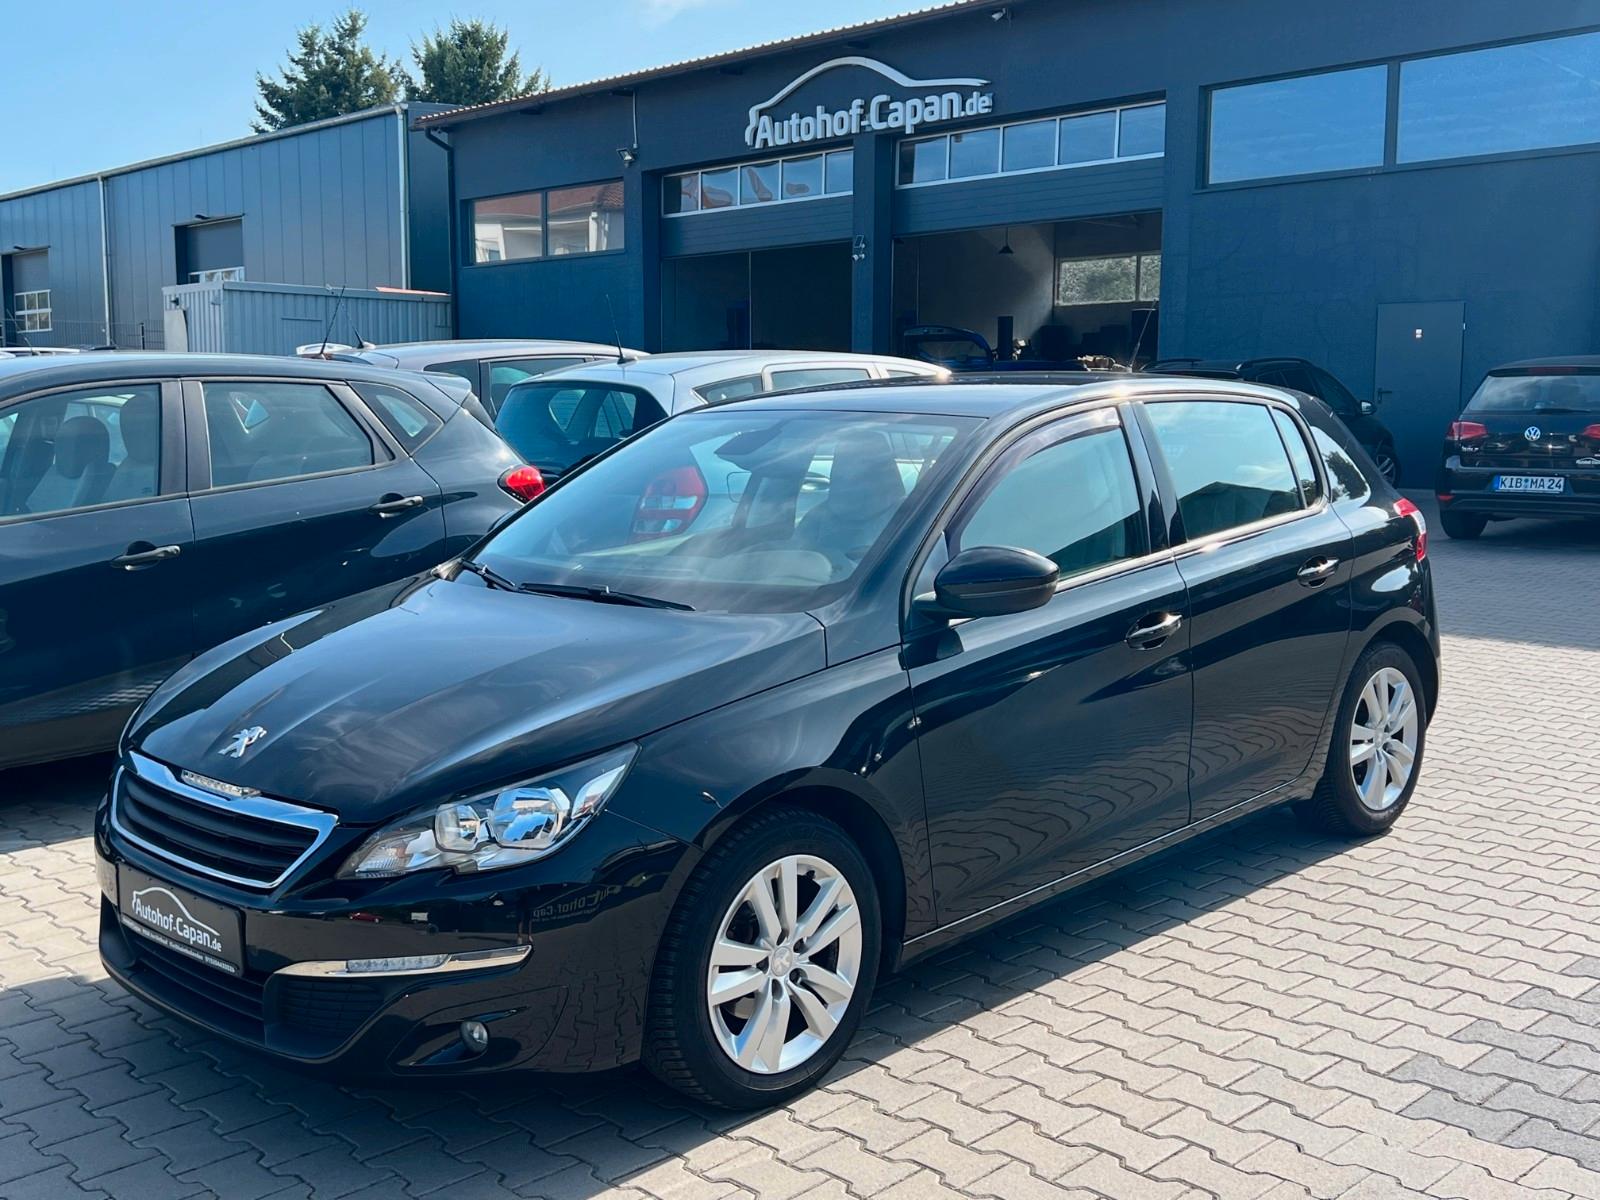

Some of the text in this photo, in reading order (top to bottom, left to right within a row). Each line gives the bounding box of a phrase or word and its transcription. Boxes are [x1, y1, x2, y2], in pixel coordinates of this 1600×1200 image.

[755, 91, 992, 148] Autohof-Capan.de
[1500, 477, 1562, 490] KIB MA 24
[135, 898, 222, 952] Autohof-Capan.de
